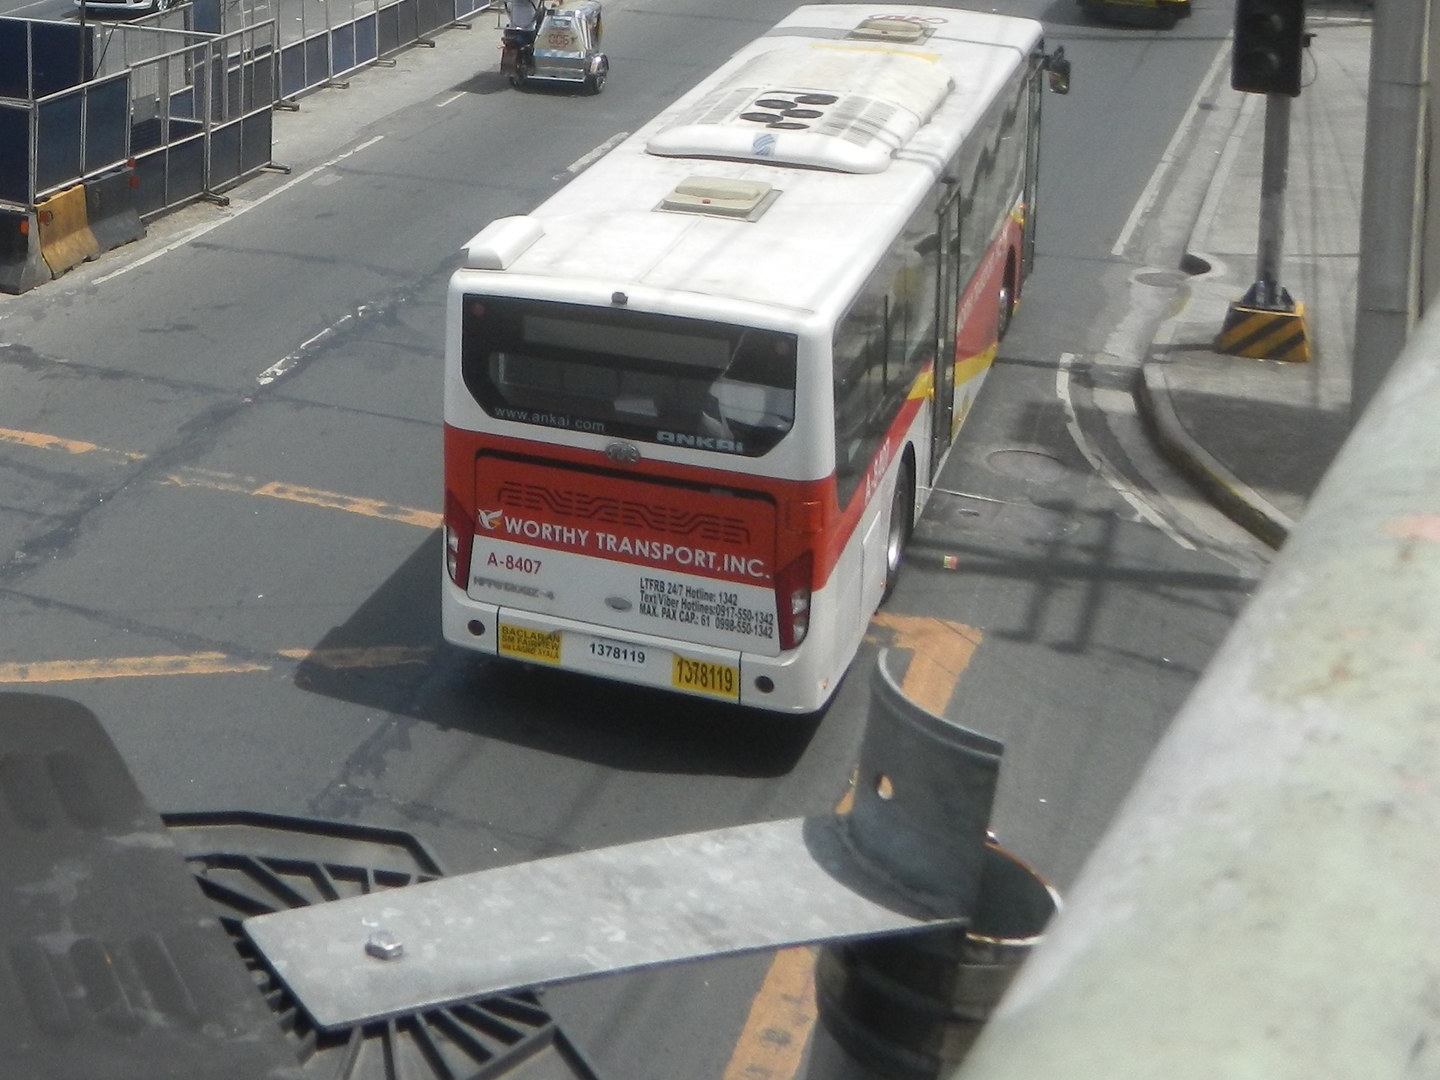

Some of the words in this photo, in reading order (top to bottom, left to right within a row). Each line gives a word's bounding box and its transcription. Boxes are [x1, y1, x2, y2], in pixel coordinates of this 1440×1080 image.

[656, 431, 744, 453] ANKAI
[504, 515, 590, 546] WORTHY
[486, 551, 543, 575] A-8407
[639, 576, 665, 593] LTFRB
[718, 591, 738, 607] 1342
[502, 625, 560, 643] BACLARAN
[661, 606, 676, 621] PAX
[700, 614, 711, 628] 61
[715, 616, 774, 640] 0998-550-1342
[517, 635, 560, 651] FAIRVIEW
[589, 642, 646, 664] 1378119
[677, 658, 733, 693] 1378119
